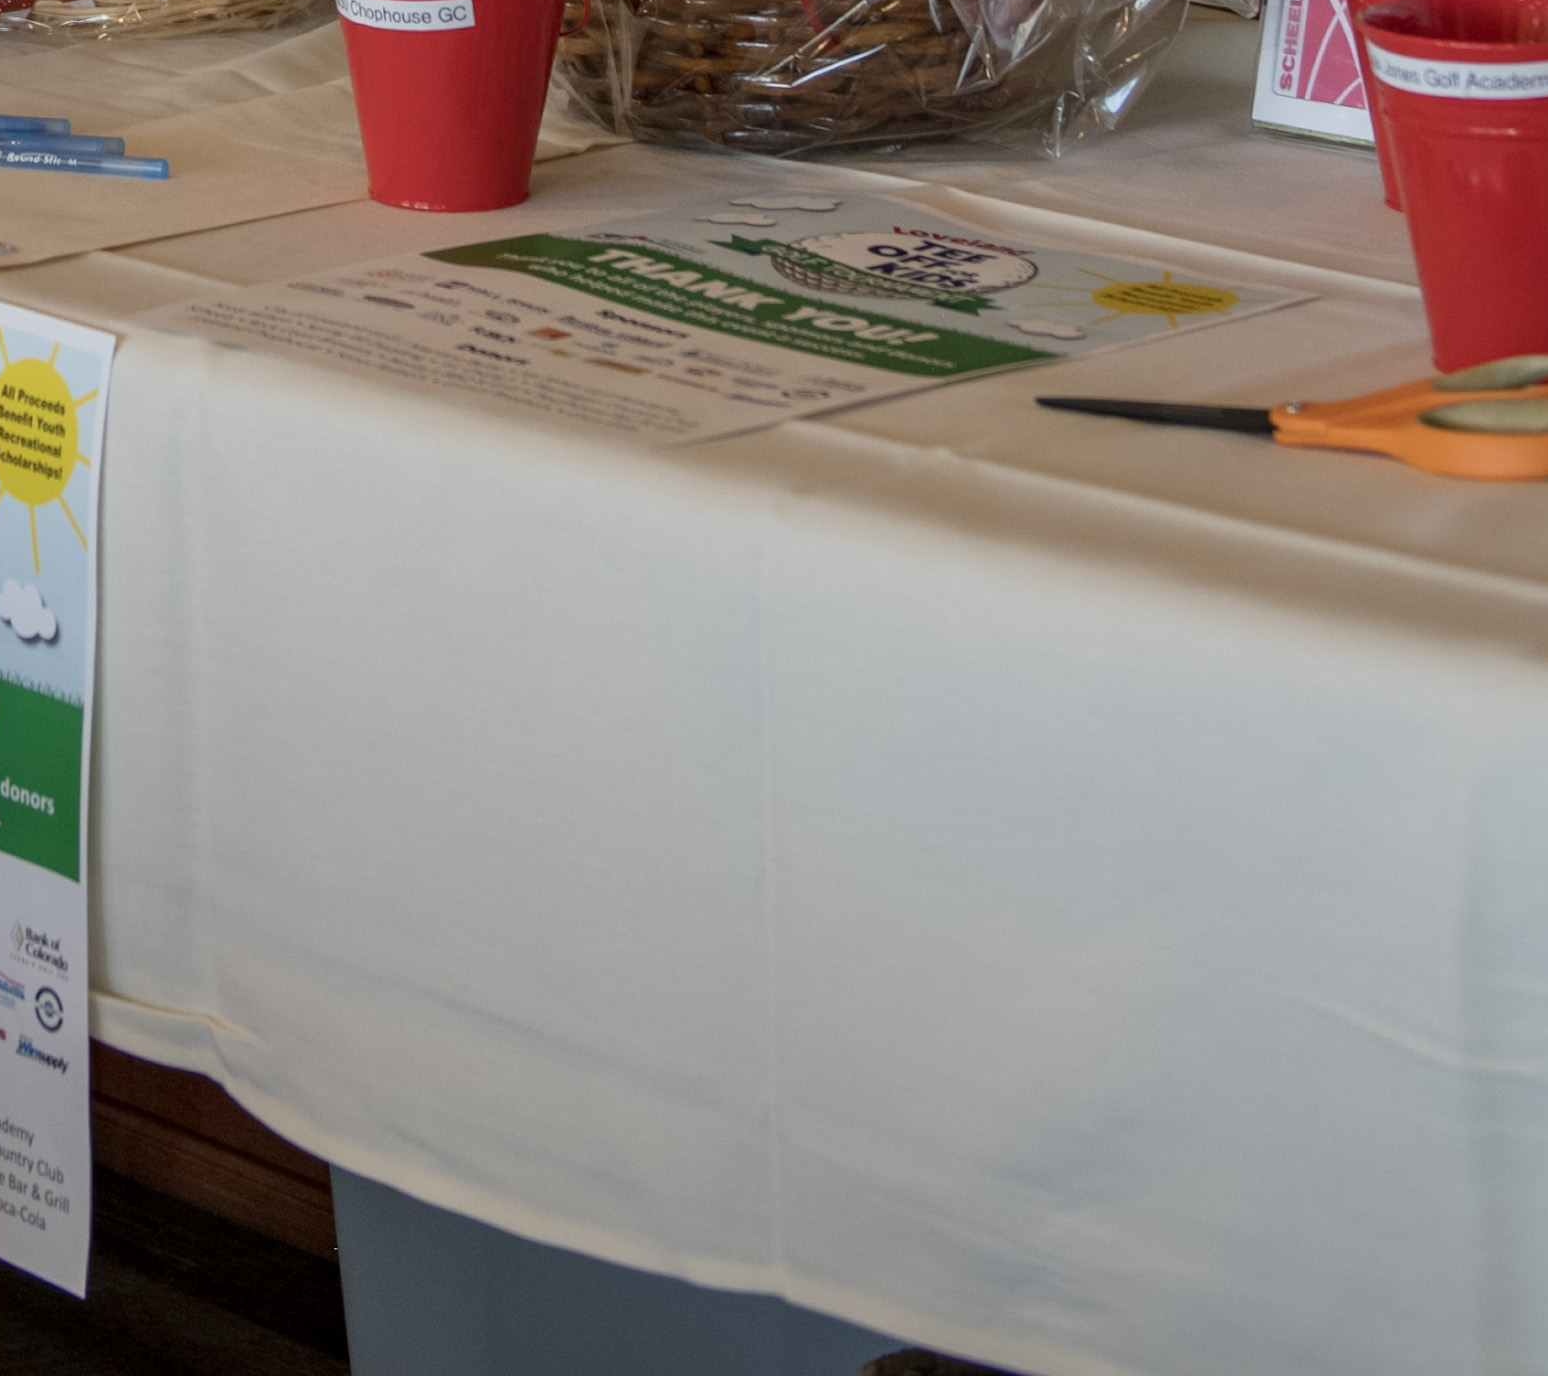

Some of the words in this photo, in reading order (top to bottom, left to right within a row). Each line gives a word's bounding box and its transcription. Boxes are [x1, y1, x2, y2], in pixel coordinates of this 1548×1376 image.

[350, 0, 432, 24] Chophouse
[438, 5, 467, 23] GC
[1424, 69, 1461, 90] Golf
[6, 151, 41, 165] Round
[42, 154, 61, 166] Stic
[587, 248, 785, 310] THANK
[782, 305, 941, 346] YOU!
[1, 384, 15, 401] All
[18, 388, 66, 416] Proceeds
[37, 416, 66, 438] Youth
[0, 776, 55, 815] donors
[25, 926, 48, 947] Bank
[37, 1159, 65, 1185] Club
